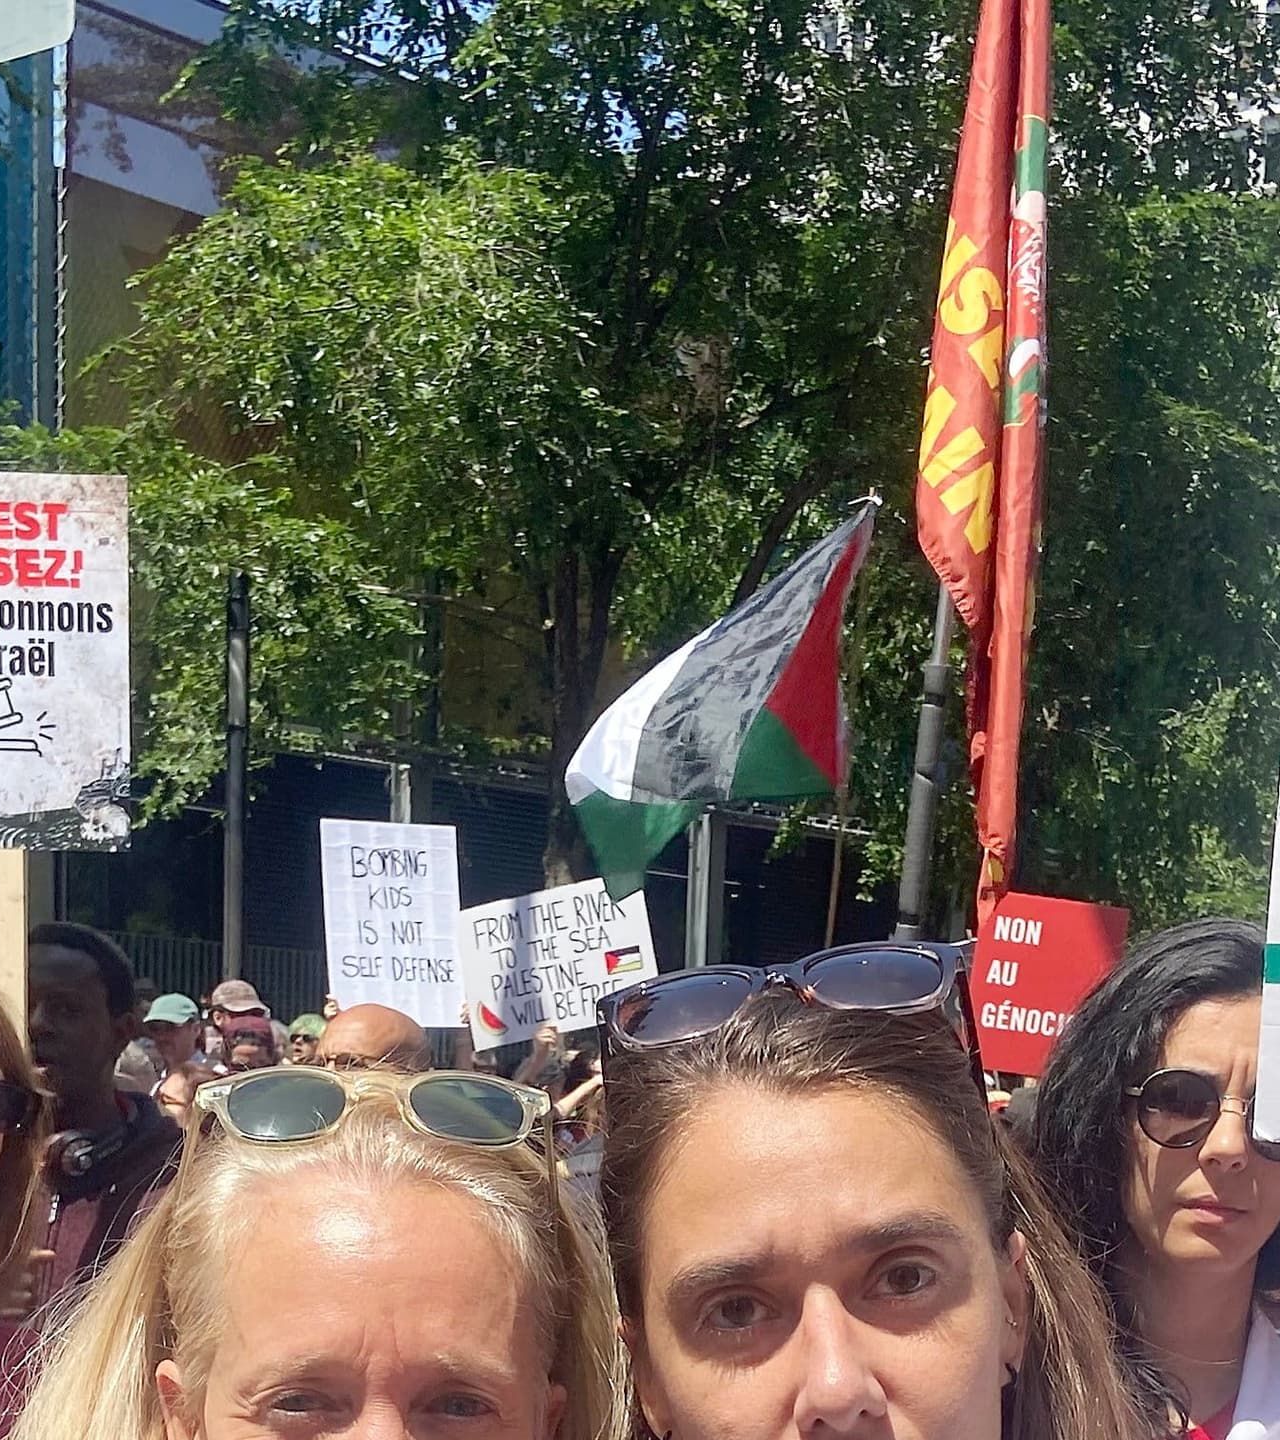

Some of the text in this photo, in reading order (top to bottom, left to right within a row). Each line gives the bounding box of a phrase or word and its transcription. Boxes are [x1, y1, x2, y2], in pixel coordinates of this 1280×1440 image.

[350, 846, 428, 879] BOMBING
[368, 884, 413, 910] KIDS
[358, 919, 424, 946] IS NOT
[472, 889, 627, 949] FROM THE RIVER
[993, 915, 1043, 946] NON
[490, 925, 612, 971] TO THE SEA
[341, 955, 455, 983] SELF DEFENSE
[490, 958, 587, 1002] PALESTINE
[985, 959, 1018, 987] AU
[510, 996, 551, 1026] WILL
[553, 991, 578, 1021] BE
[980, 999, 1074, 1037] GÉNOCI
